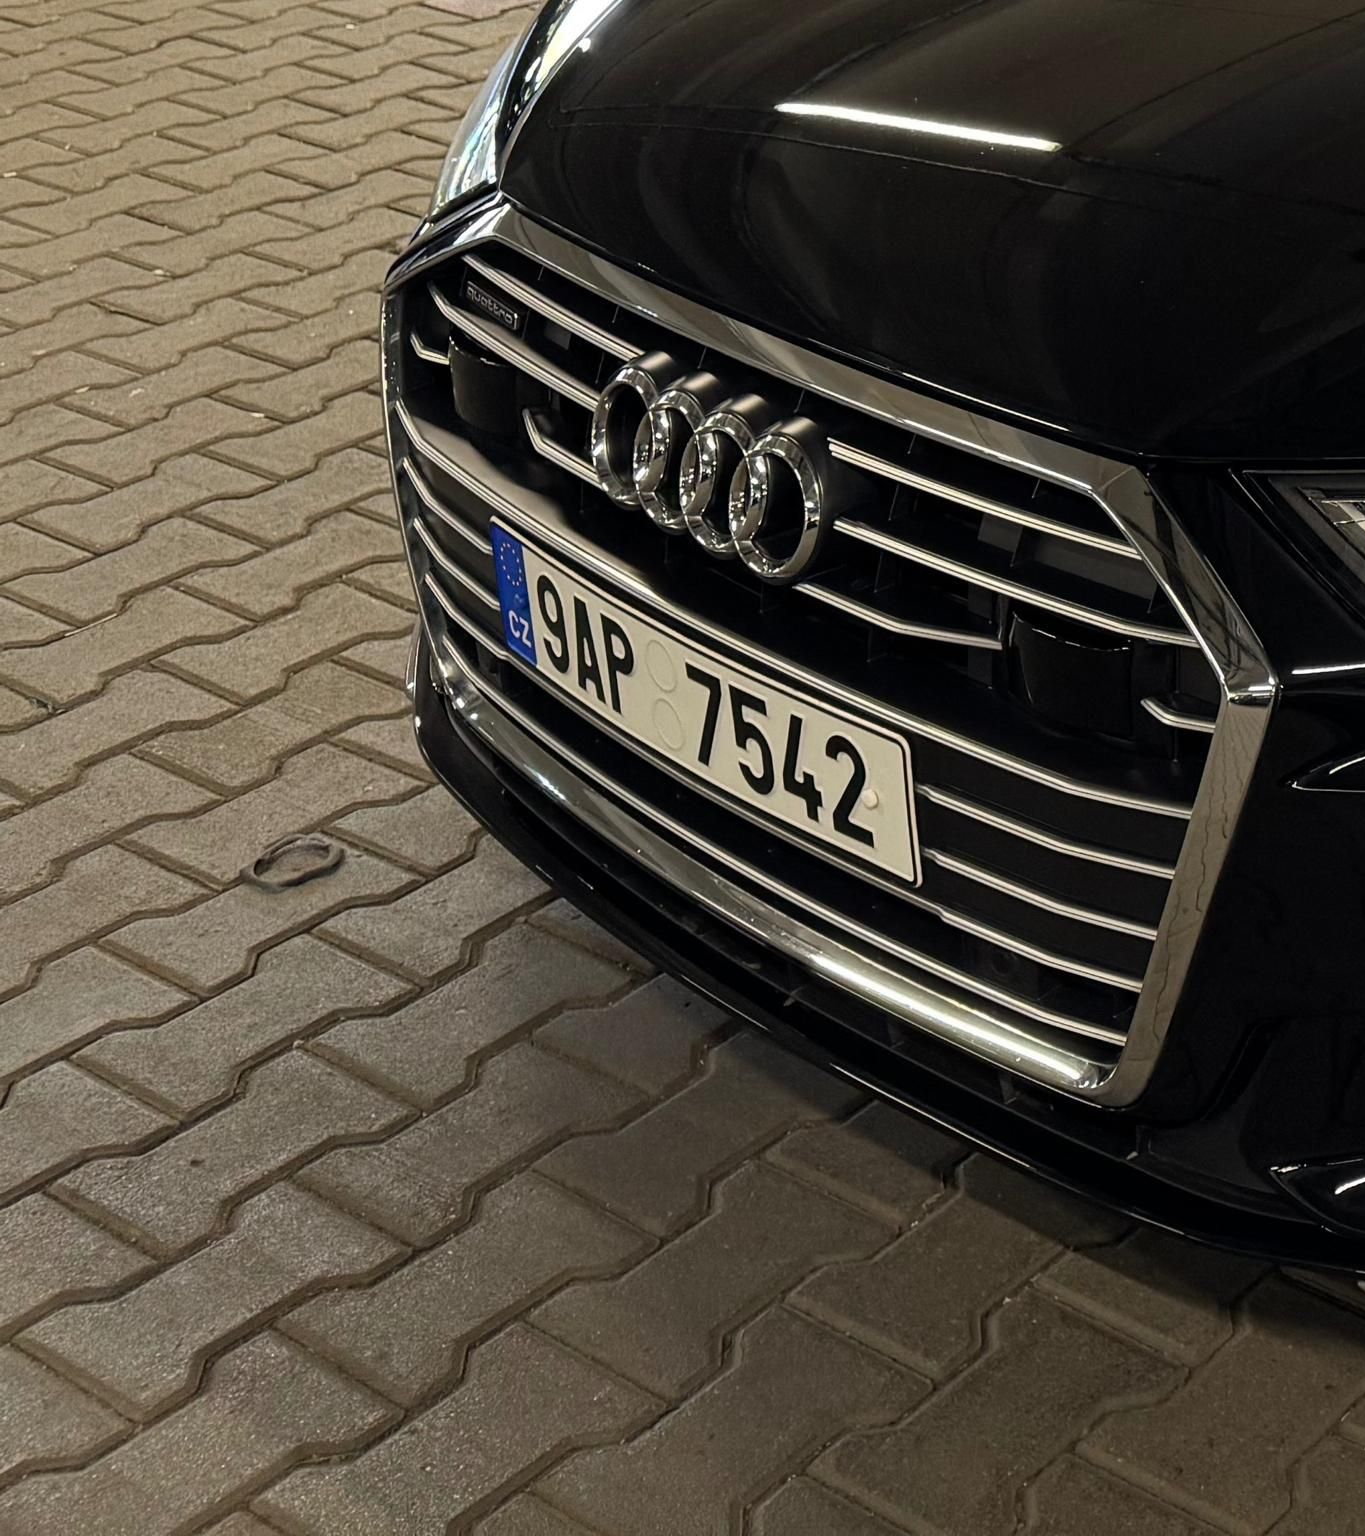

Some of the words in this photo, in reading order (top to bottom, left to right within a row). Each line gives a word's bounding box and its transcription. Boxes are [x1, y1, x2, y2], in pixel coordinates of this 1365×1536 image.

[466, 285, 513, 325] quattro
[508, 608, 533, 648] CZ
[536, 573, 635, 718] 9AP
[684, 660, 876, 850] 7542
